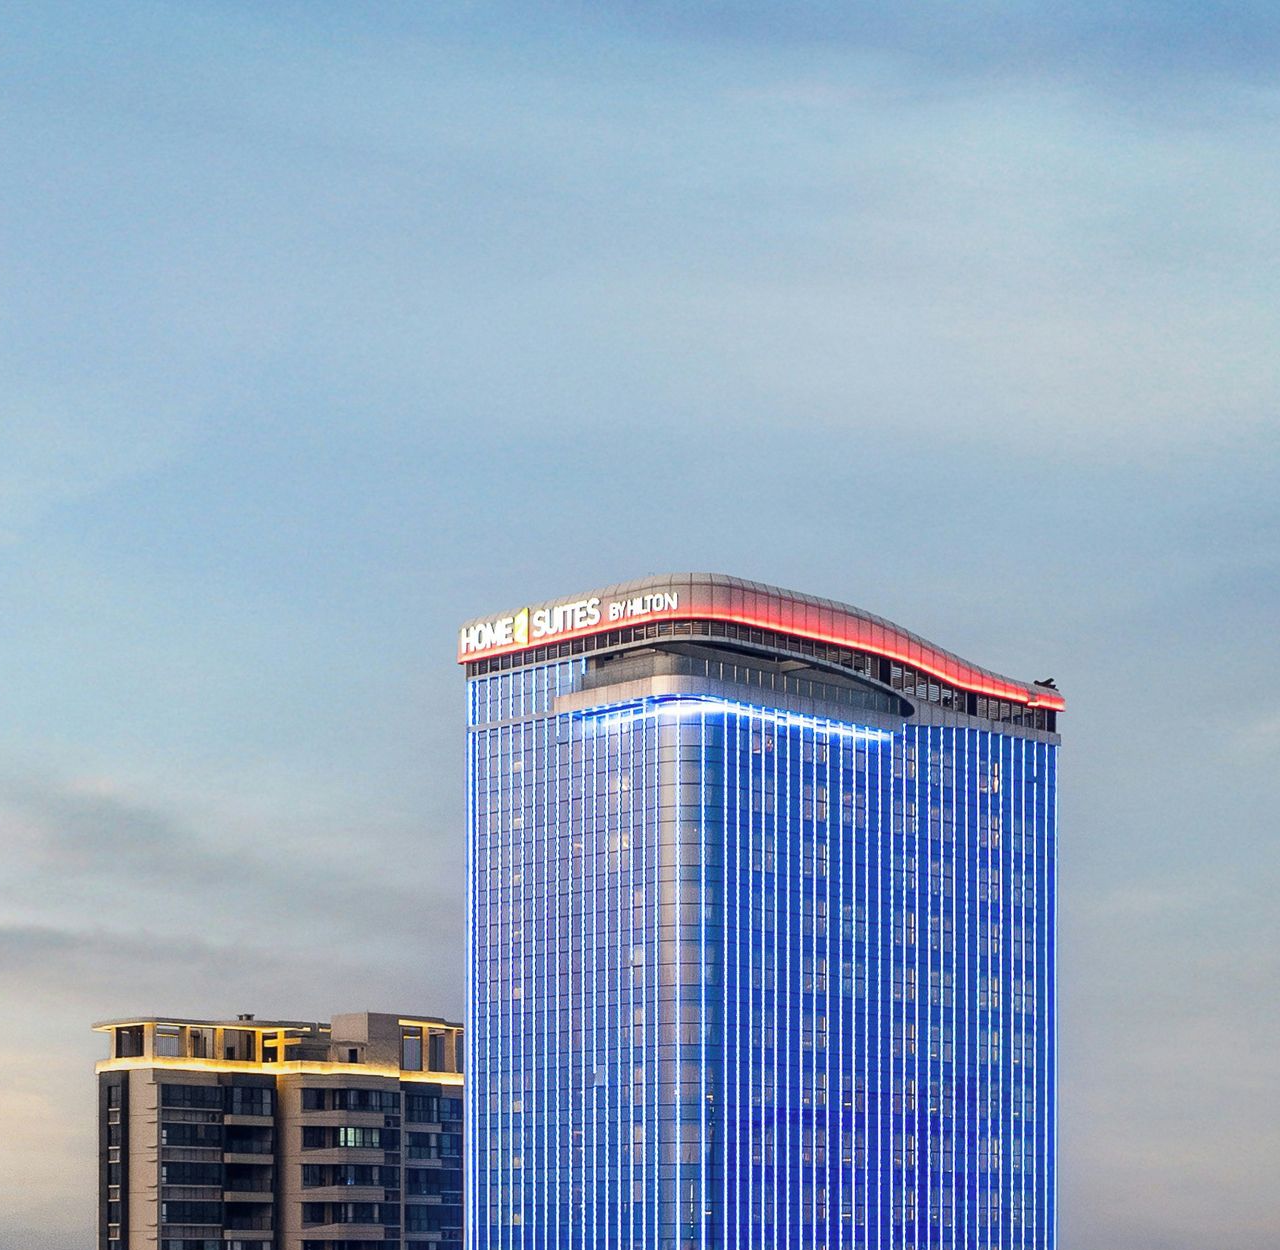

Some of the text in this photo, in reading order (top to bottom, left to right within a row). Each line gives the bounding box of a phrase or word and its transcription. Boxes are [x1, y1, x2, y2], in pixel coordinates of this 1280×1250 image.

[461, 617, 514, 654] HOME
[532, 597, 601, 638] SUITES
[609, 601, 626, 621] BY
[626, 592, 677, 618] HILTON
